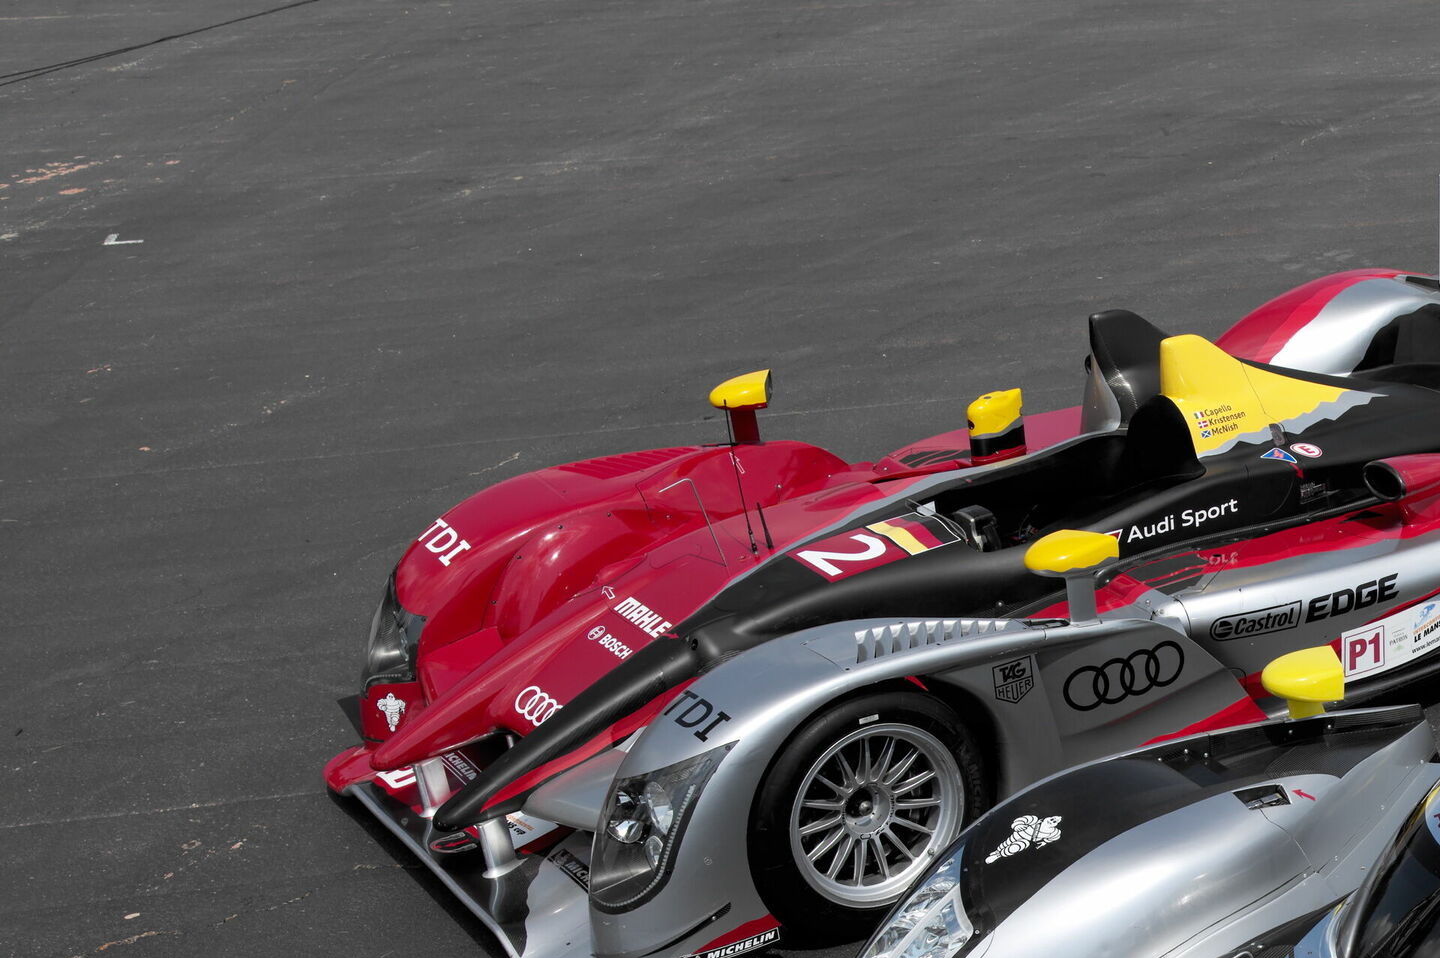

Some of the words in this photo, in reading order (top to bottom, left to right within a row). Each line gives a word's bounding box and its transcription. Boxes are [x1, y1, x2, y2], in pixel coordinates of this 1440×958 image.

[1204, 404, 1232, 417] Capello
[1208, 410, 1246, 427] Kristensen
[1211, 422, 1239, 437] McNish
[1127, 514, 1175, 543] Audi
[1181, 498, 1239, 527] Sport
[417, 518, 472, 567] TDI
[796, 533, 887, 576] 2
[1305, 573, 1399, 624] EDGE
[613, 597, 673, 639] MAHLE
[1233, 607, 1295, 635] Castrol
[598, 634, 633, 660] BOSCH
[1349, 632, 1381, 671] P1
[1414, 632, 1422, 643] LE
[999, 662, 1026, 683] TAG
[997, 679, 1032, 701] HEUER
[663, 689, 733, 743] TDI
